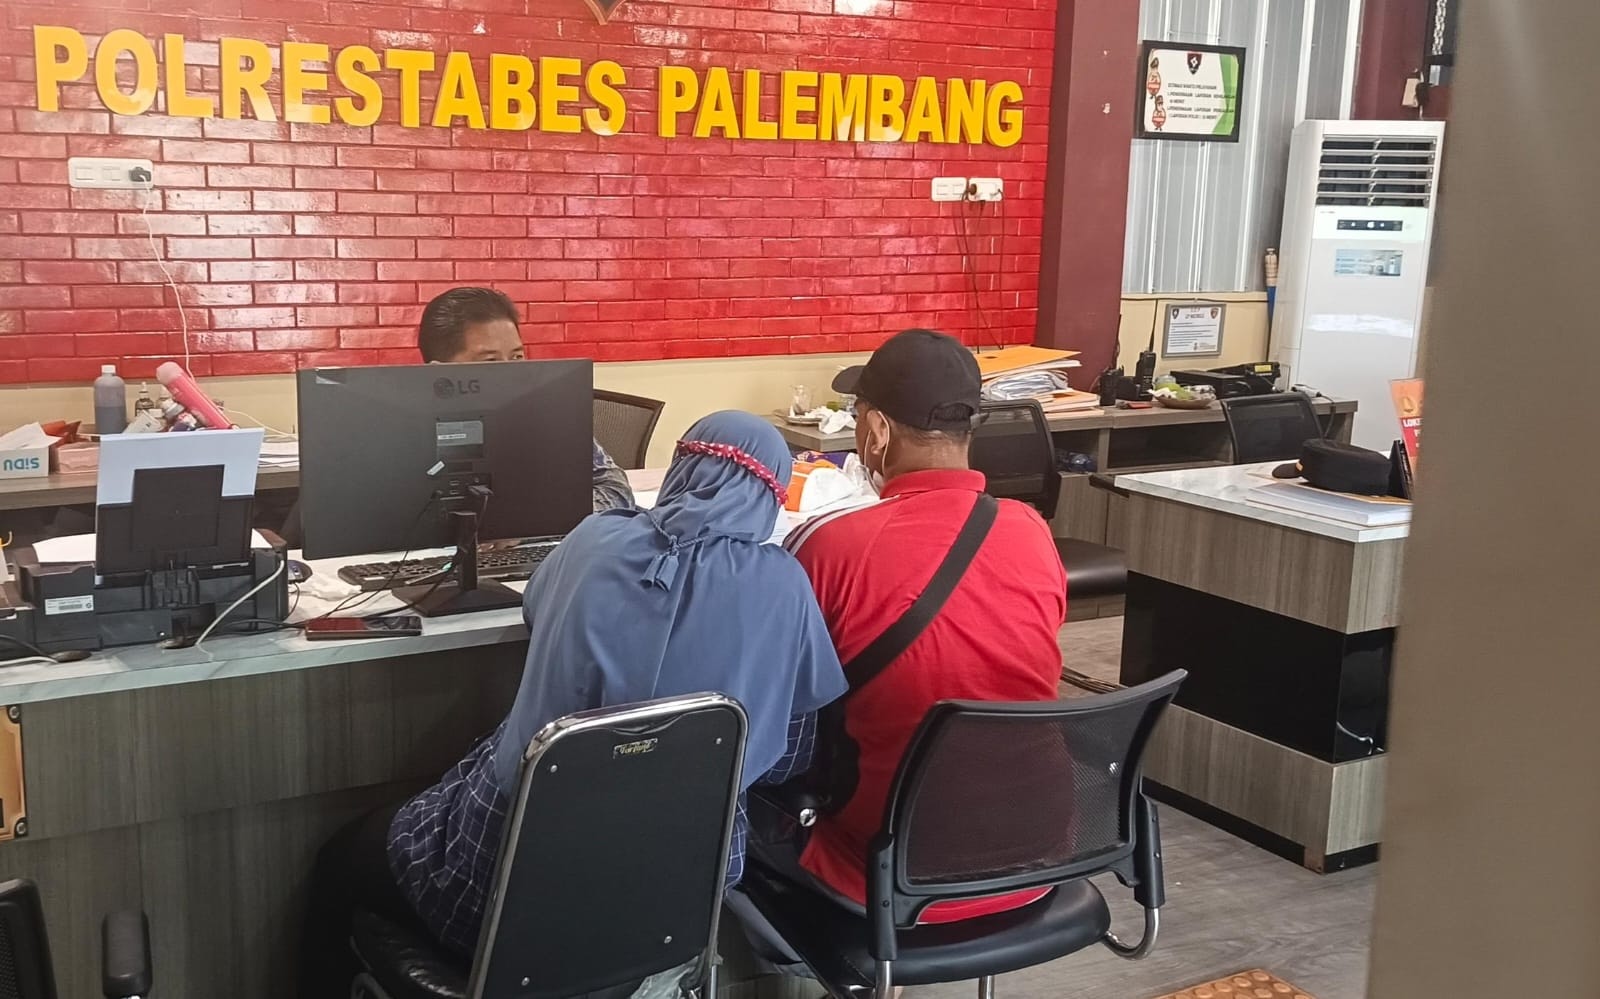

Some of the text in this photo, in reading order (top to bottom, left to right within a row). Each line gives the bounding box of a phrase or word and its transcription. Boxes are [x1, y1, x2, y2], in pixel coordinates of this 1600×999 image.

[34, 25, 1024, 148] POLRESTABES PALEMBANG
[457, 379, 481, 394] LG
